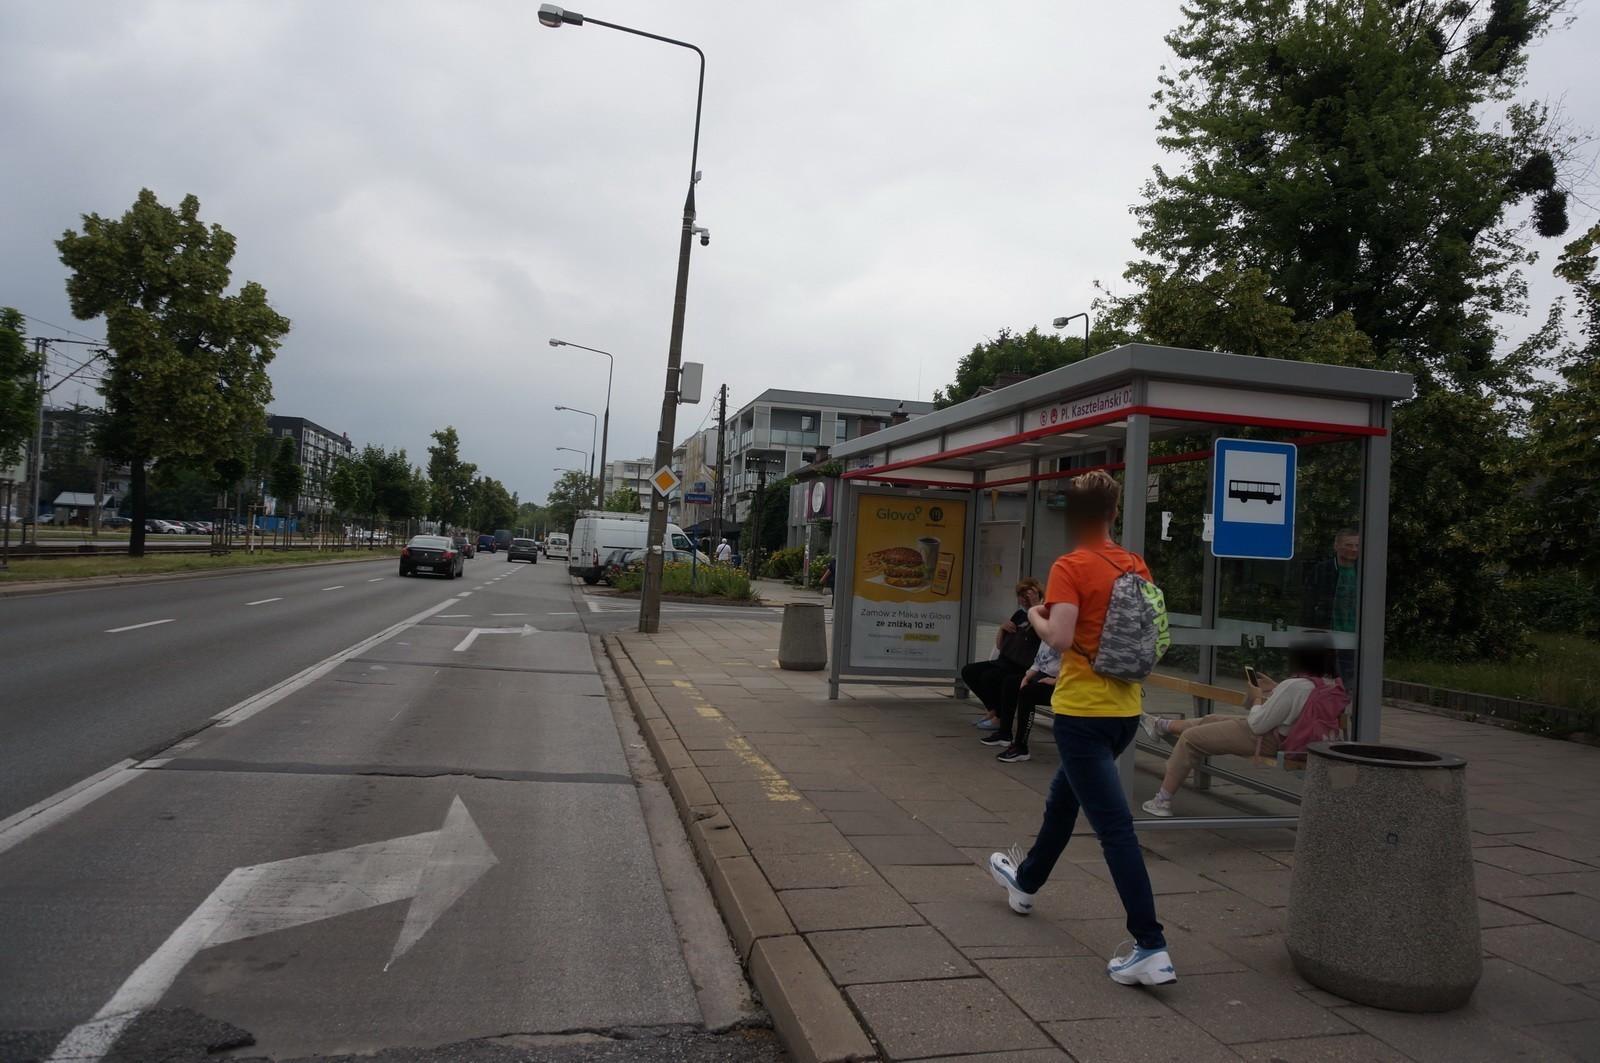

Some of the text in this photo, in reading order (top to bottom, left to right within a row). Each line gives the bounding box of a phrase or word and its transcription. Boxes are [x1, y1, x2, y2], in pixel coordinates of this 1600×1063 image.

[1061, 408, 1070, 421] Pl.
[861, 608, 889, 617] Zamów
[898, 610, 919, 619] Maka
[929, 612, 951, 620] Glovo
[888, 620, 912, 629] zniżką
[914, 621, 923, 629] 10
